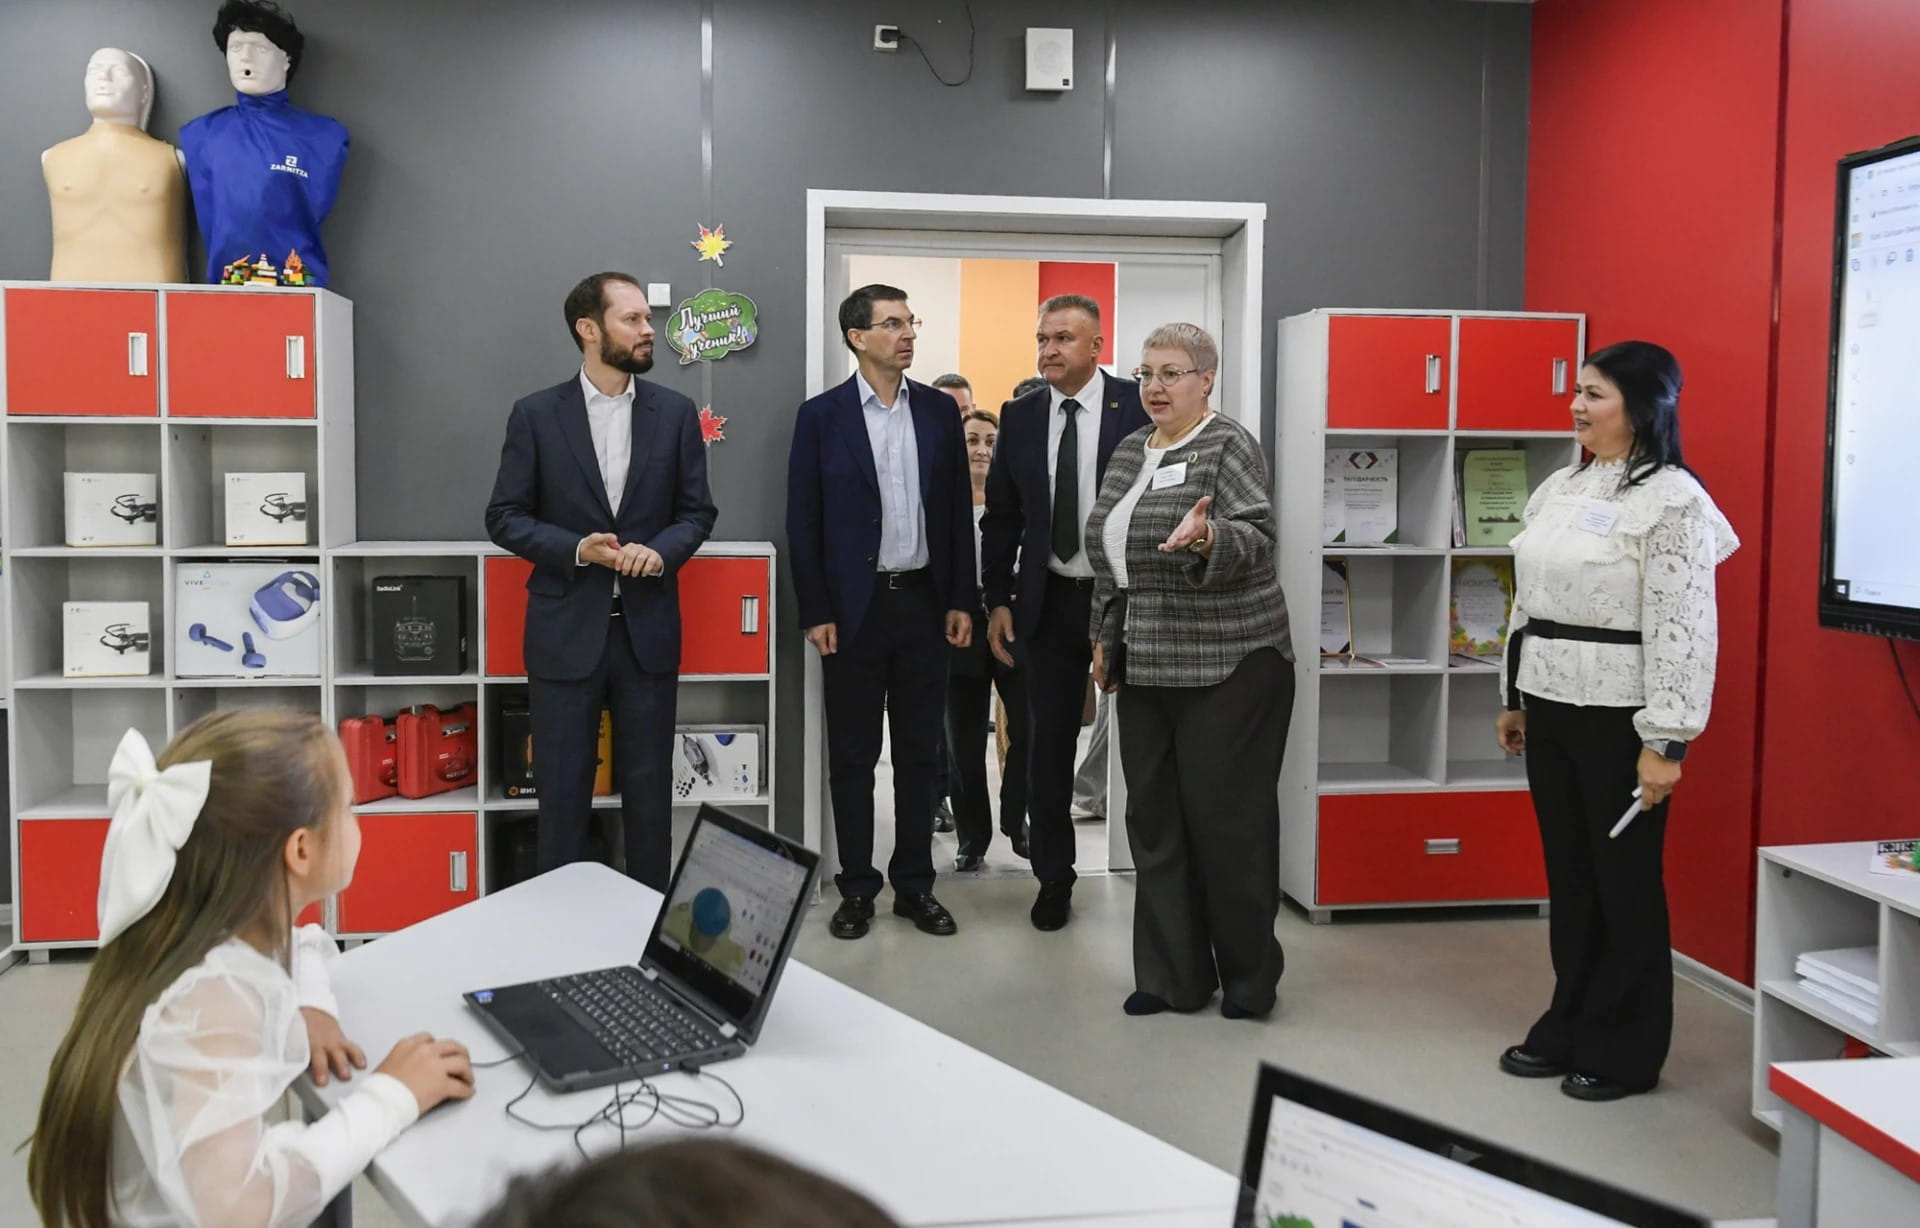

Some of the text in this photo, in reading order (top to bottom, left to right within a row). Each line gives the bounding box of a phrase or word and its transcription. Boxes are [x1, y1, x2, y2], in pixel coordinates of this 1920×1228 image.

[270, 163, 309, 178] ZARNITZA
[679, 302, 741, 331] Лучший
[689, 325, 742, 359] ученик!
